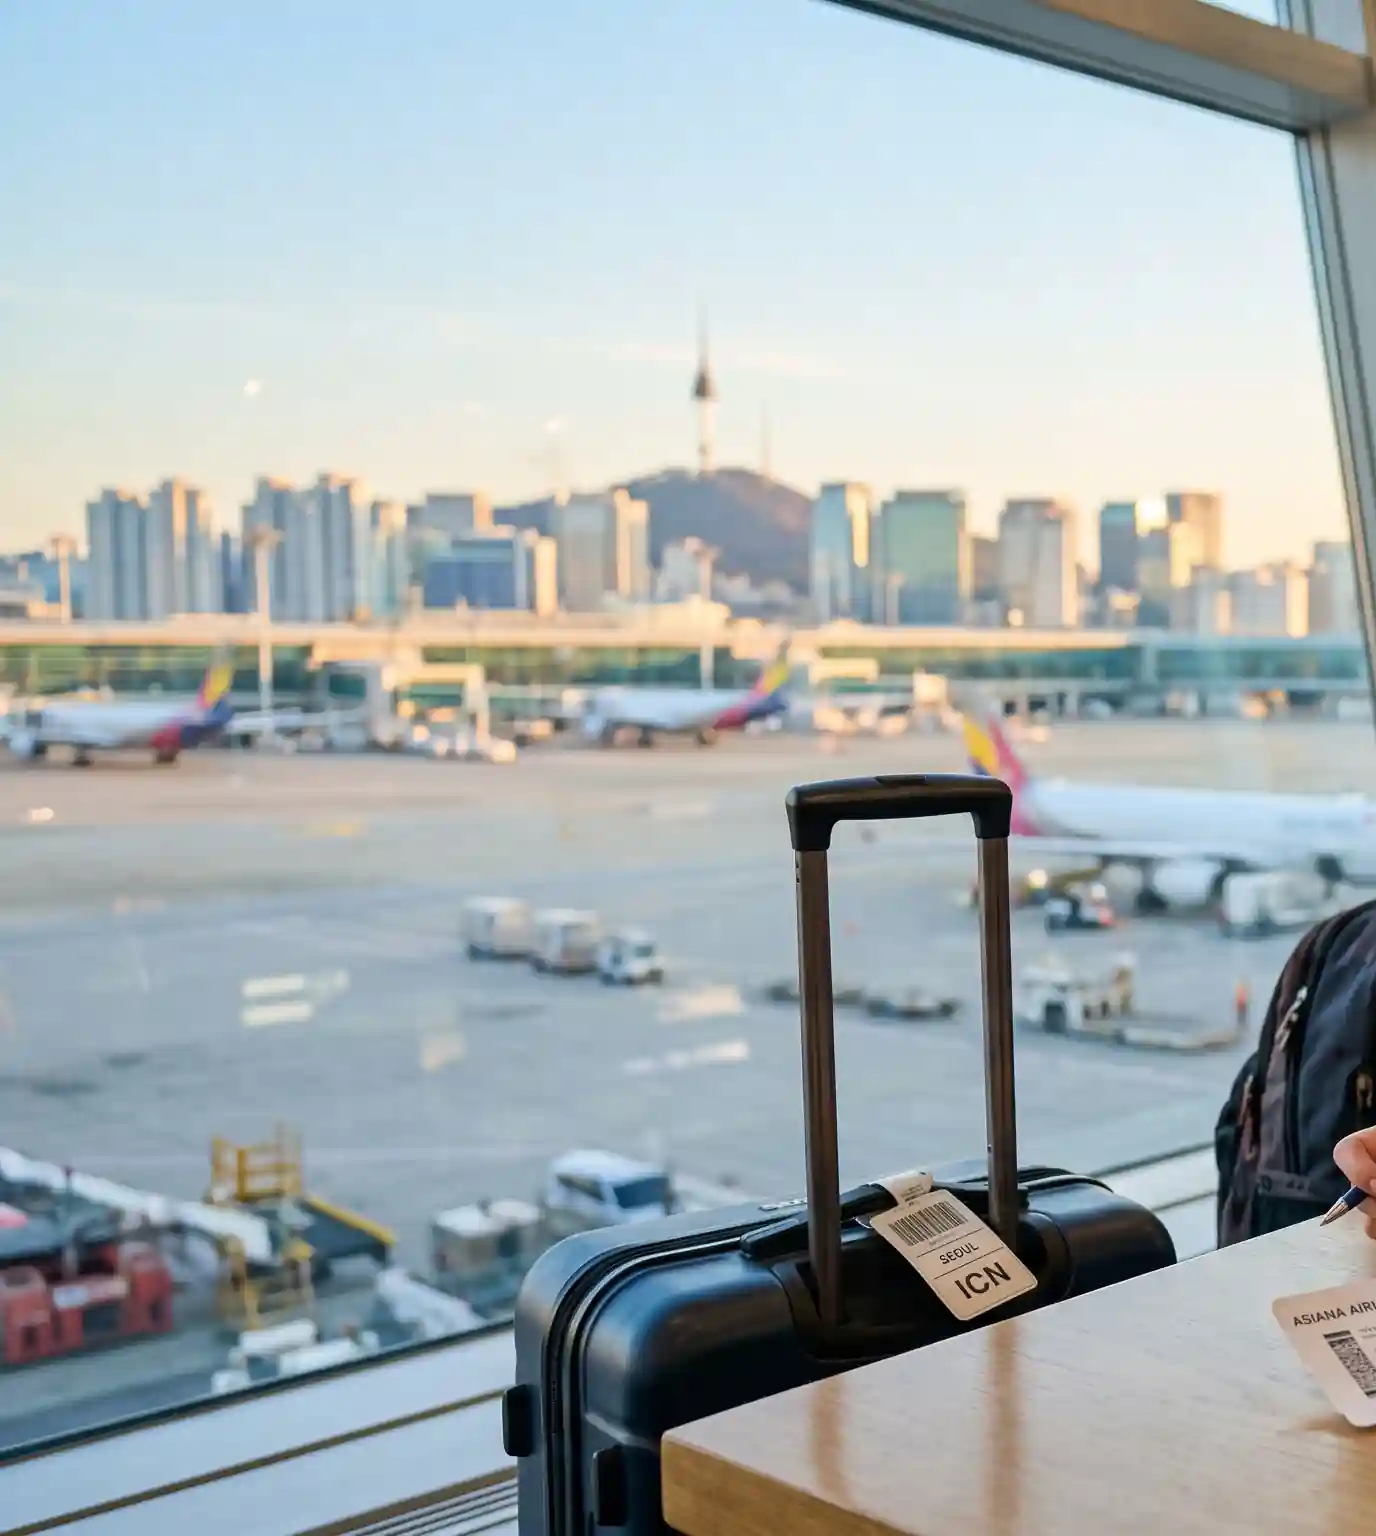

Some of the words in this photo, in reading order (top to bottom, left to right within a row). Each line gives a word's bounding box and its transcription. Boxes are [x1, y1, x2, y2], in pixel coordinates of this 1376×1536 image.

[939, 1242, 980, 1265] SEOUL
[954, 1261, 1011, 1299] ICN
[1293, 1307, 1347, 1327] ASIANA
